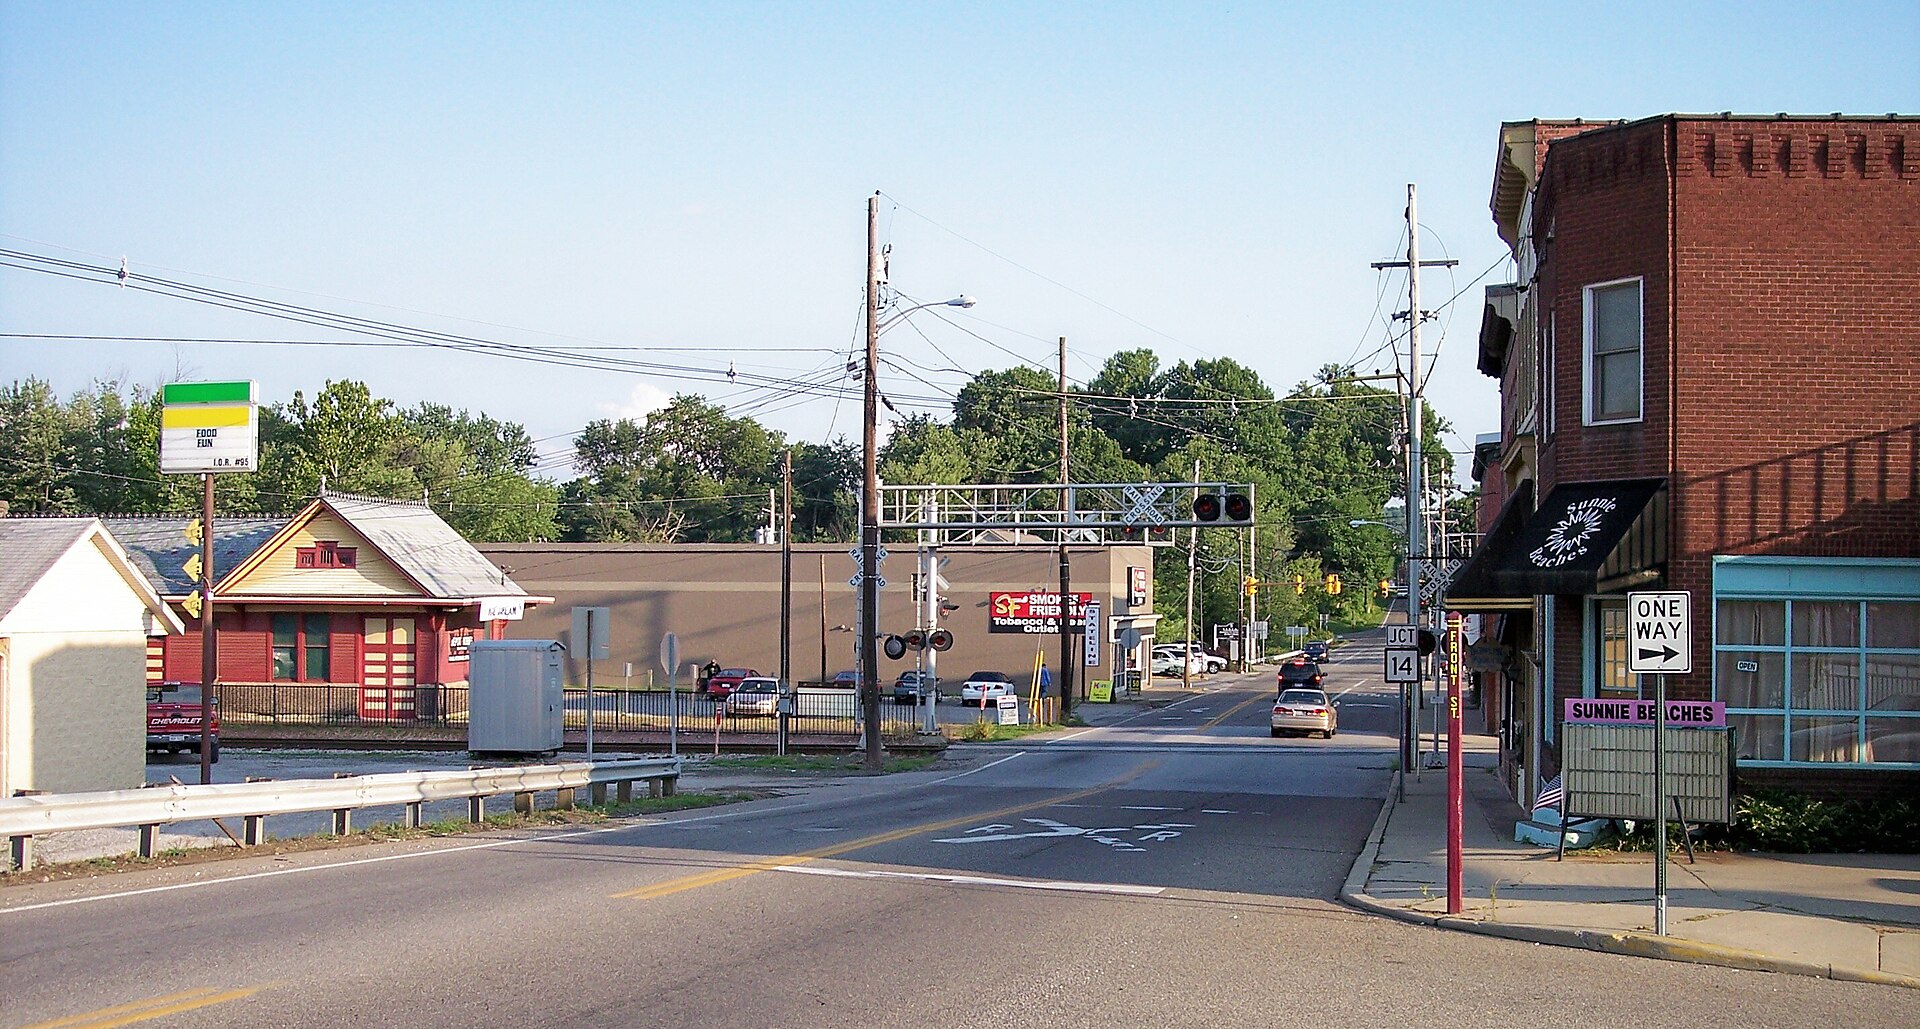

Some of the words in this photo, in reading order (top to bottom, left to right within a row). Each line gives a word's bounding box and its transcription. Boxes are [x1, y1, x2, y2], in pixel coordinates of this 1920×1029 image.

[196, 428, 217, 438] FOOD
[197, 438, 213, 448] FUN
[1529, 546, 1588, 568] Beaches
[1419, 561, 1460, 600] CROSSING
[1637, 600, 1682, 618] ONE
[993, 617, 1044, 626] Tobacco
[1023, 625, 1060, 633] Outlet
[1390, 628, 1415, 644] JCT
[1636, 621, 1683, 640] WAY
[1391, 656, 1412, 676] 14
[1450, 630, 1458, 686] FRONT
[1738, 661, 1757, 671] OPEN
[1572, 702, 1631, 720] SUNNIE
[151, 717, 202, 725] CHEVROLET
